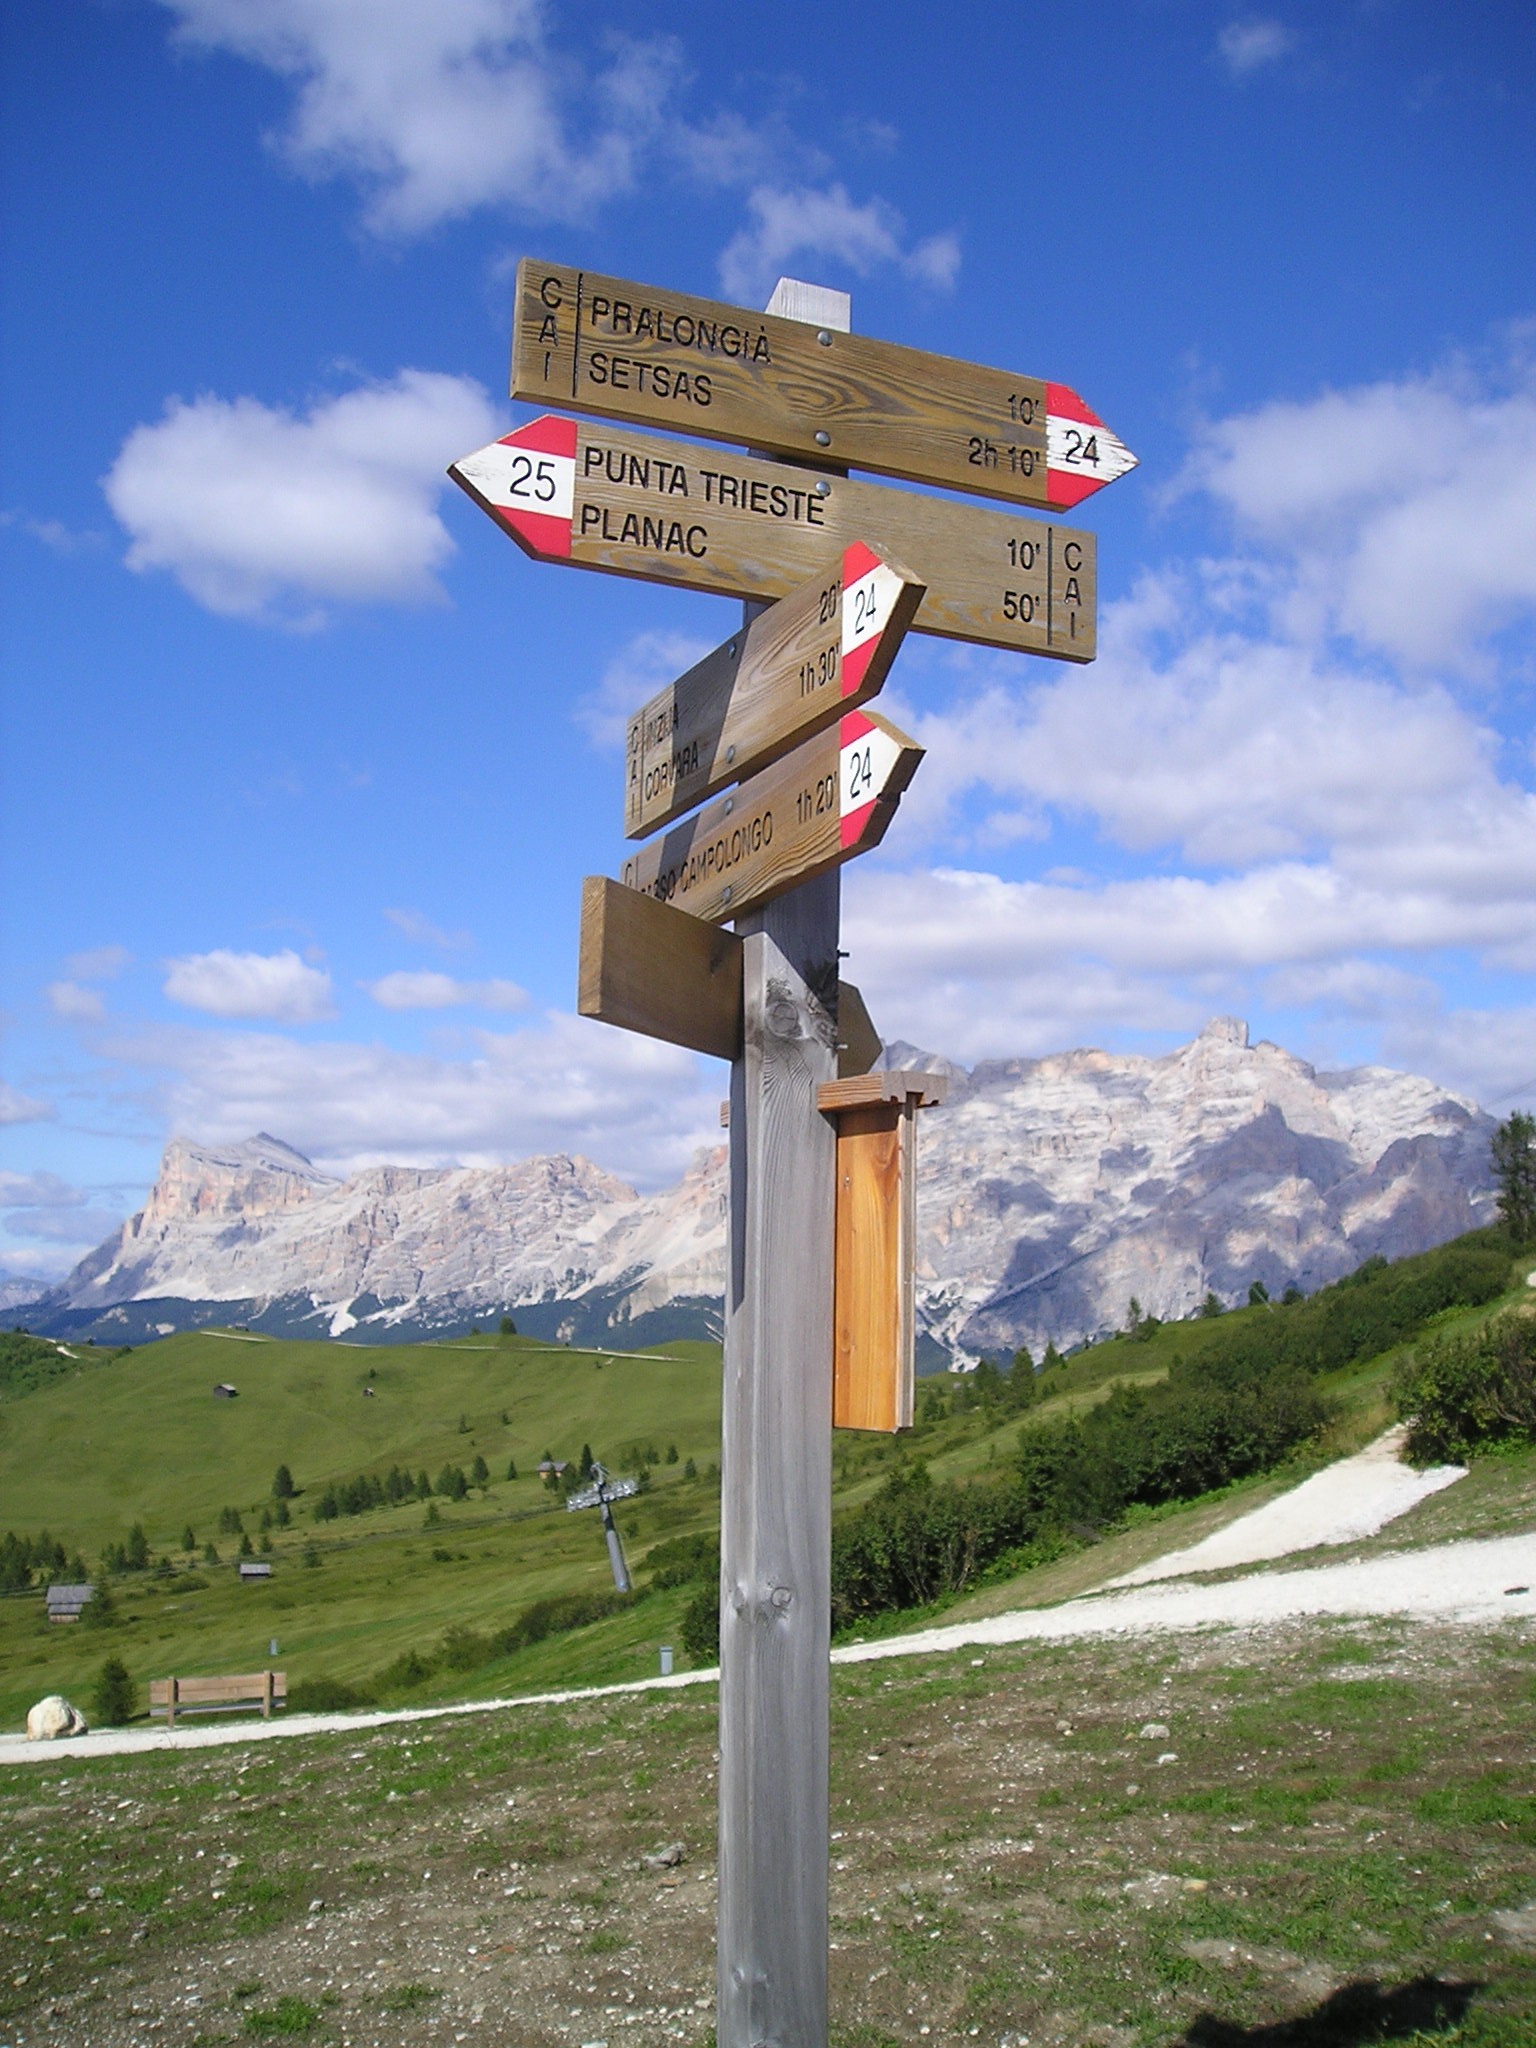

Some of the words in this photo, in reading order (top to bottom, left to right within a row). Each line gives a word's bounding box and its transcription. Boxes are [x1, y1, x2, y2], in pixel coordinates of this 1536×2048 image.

[539, 277, 562, 382] CAI
[591, 296, 771, 365] PRALONGIÀ
[589, 352, 712, 406] SETSAS
[968, 437, 998, 466] 2h
[510, 456, 556, 501] 25
[585, 446, 689, 497] PUNTA
[700, 469, 825, 525] TRIESTE
[1064, 430, 1100, 468] 24
[581, 504, 708, 558] PLANAC
[855, 583, 876, 635] 24
[1064, 542, 1082, 639] CAI
[645, 741, 699, 801] CORVARA
[800, 662, 815, 697] 1h
[850, 746, 872, 799] 24
[641, 869, 676, 902] SSO
[680, 811, 773, 892] CAMPOLONGO
[797, 789, 812, 825] 1h
